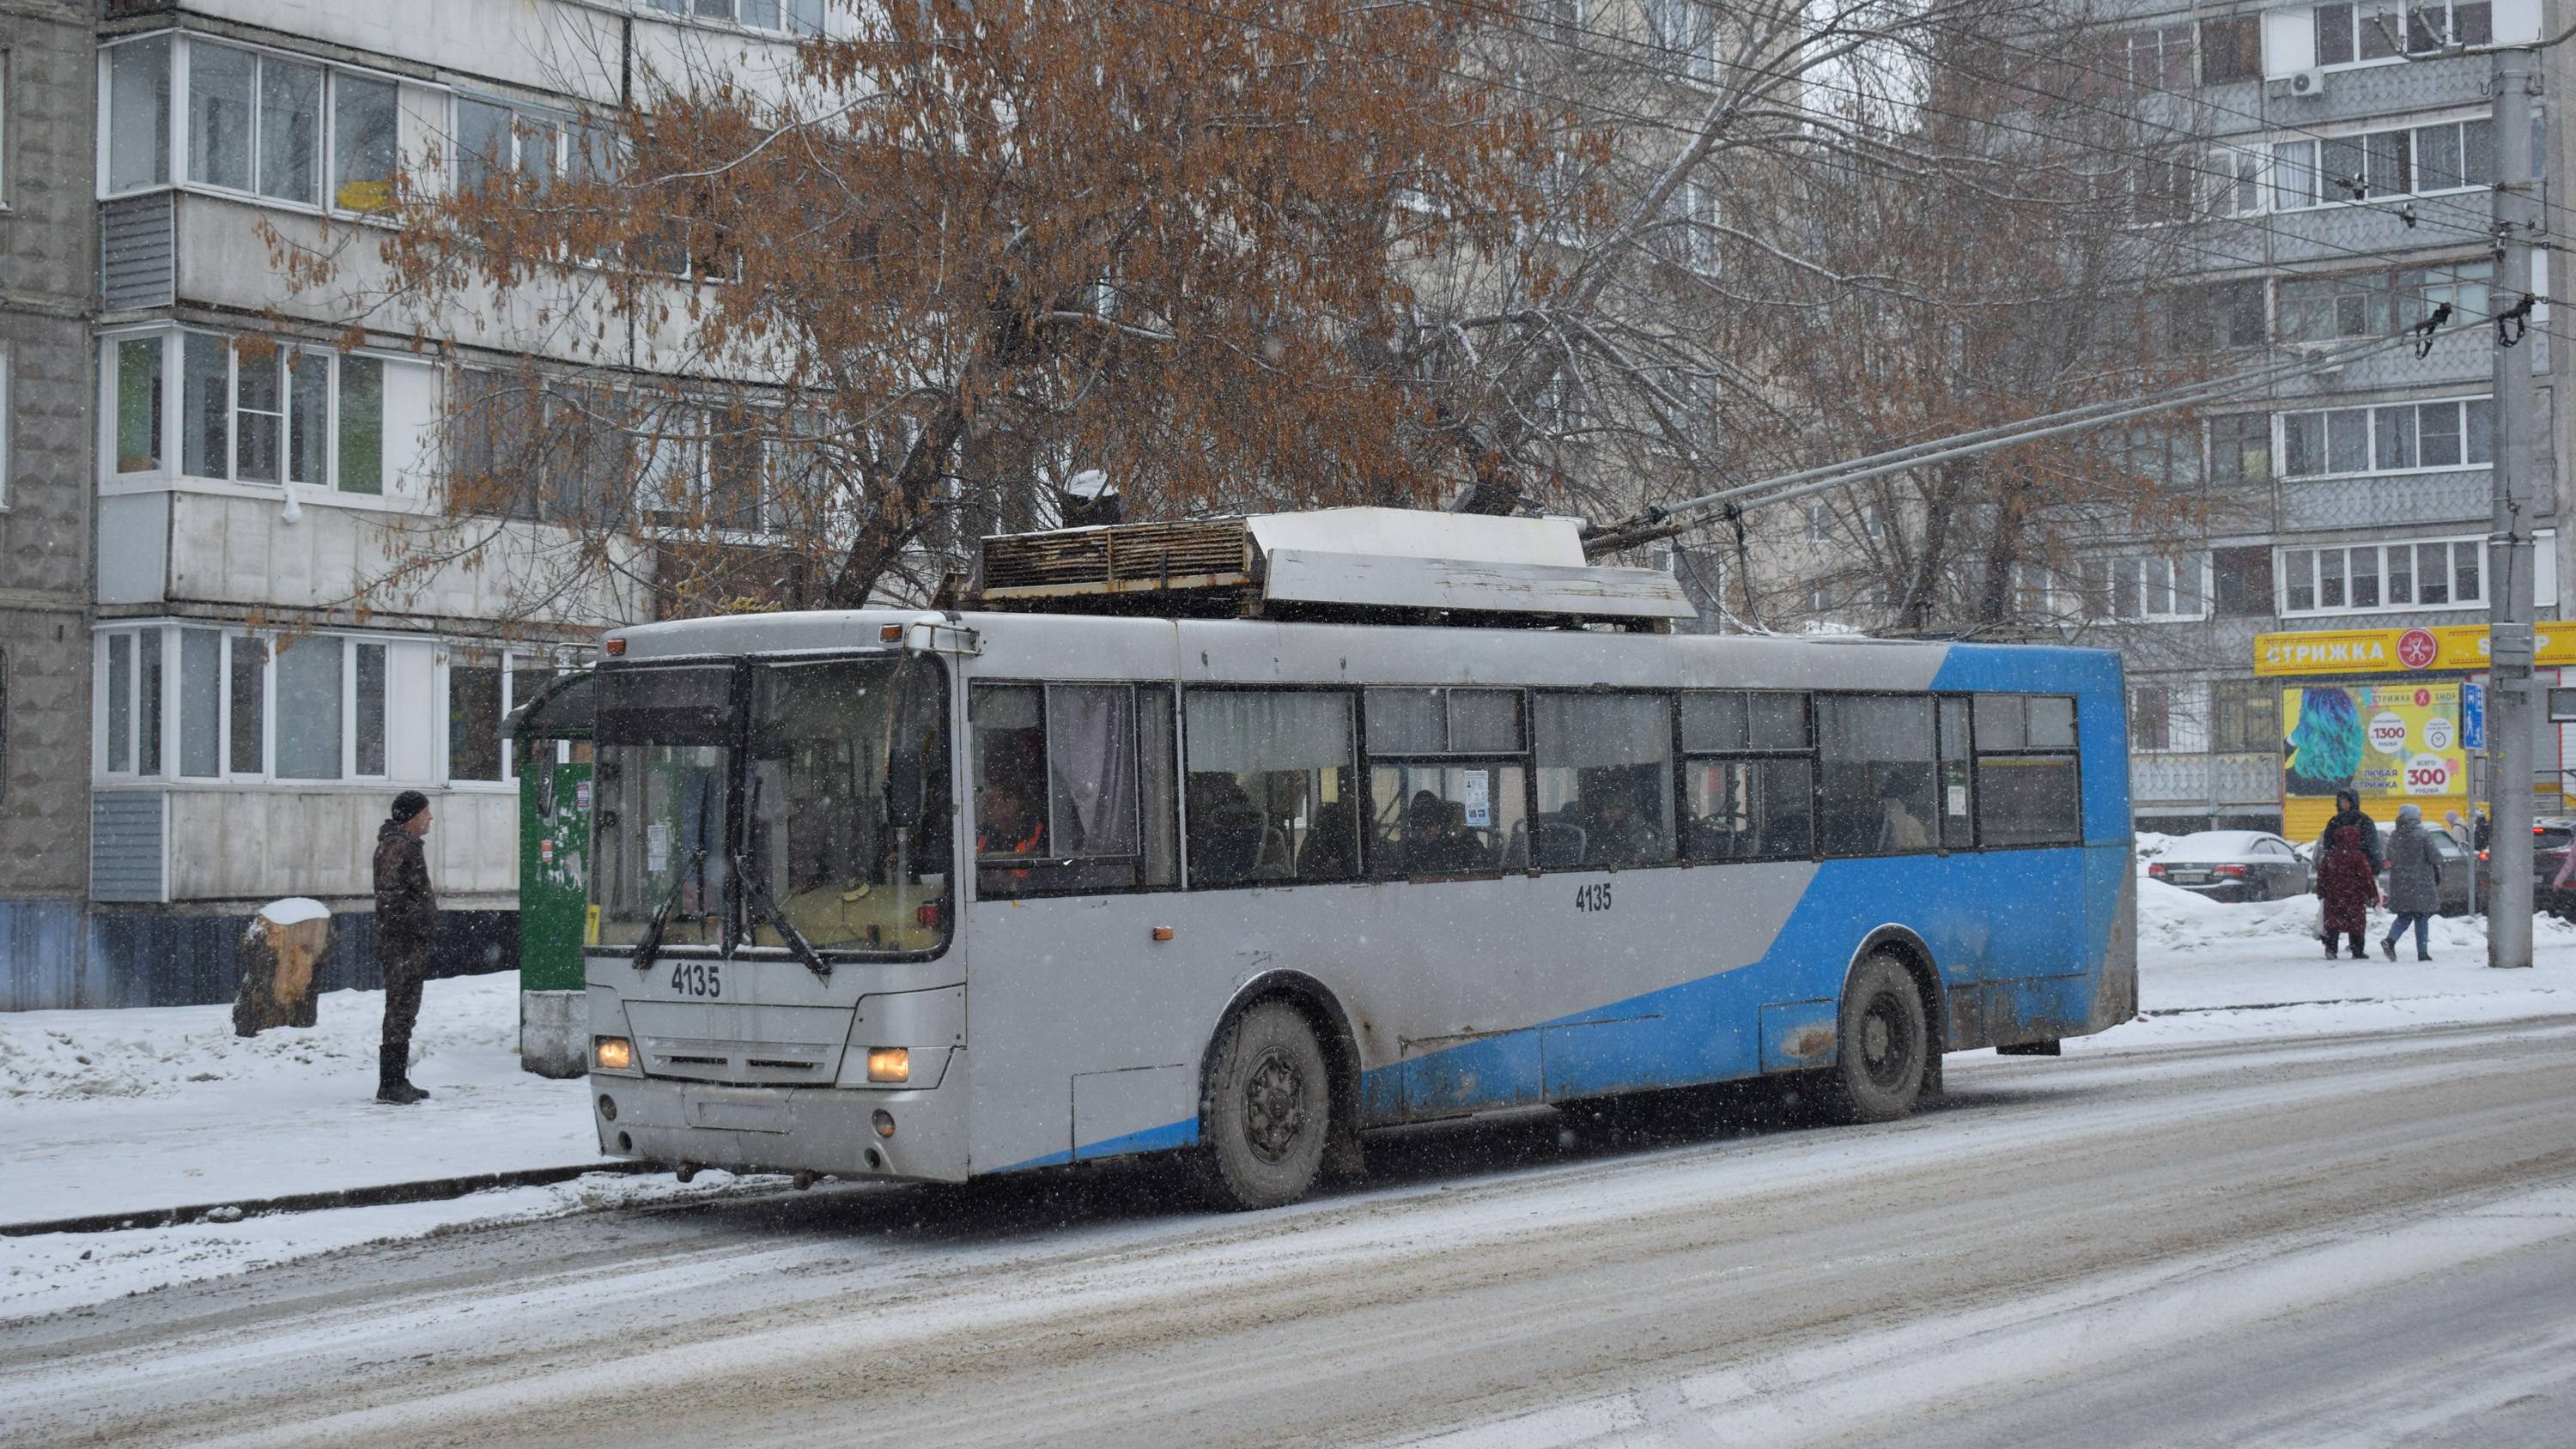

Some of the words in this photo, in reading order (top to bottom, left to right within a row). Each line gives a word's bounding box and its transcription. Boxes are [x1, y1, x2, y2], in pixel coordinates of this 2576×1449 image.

[2266, 641, 2385, 664] СТРИЖКА
[2477, 635, 2550, 656] SP
[2434, 693, 2457, 701] SHOP
[2373, 727, 2405, 739] 1300
[2363, 769, 2398, 778] ЛЮБАЯ
[2408, 768, 2445, 785] 300
[1576, 882, 1612, 912] 4135
[671, 962, 721, 997] 4135
